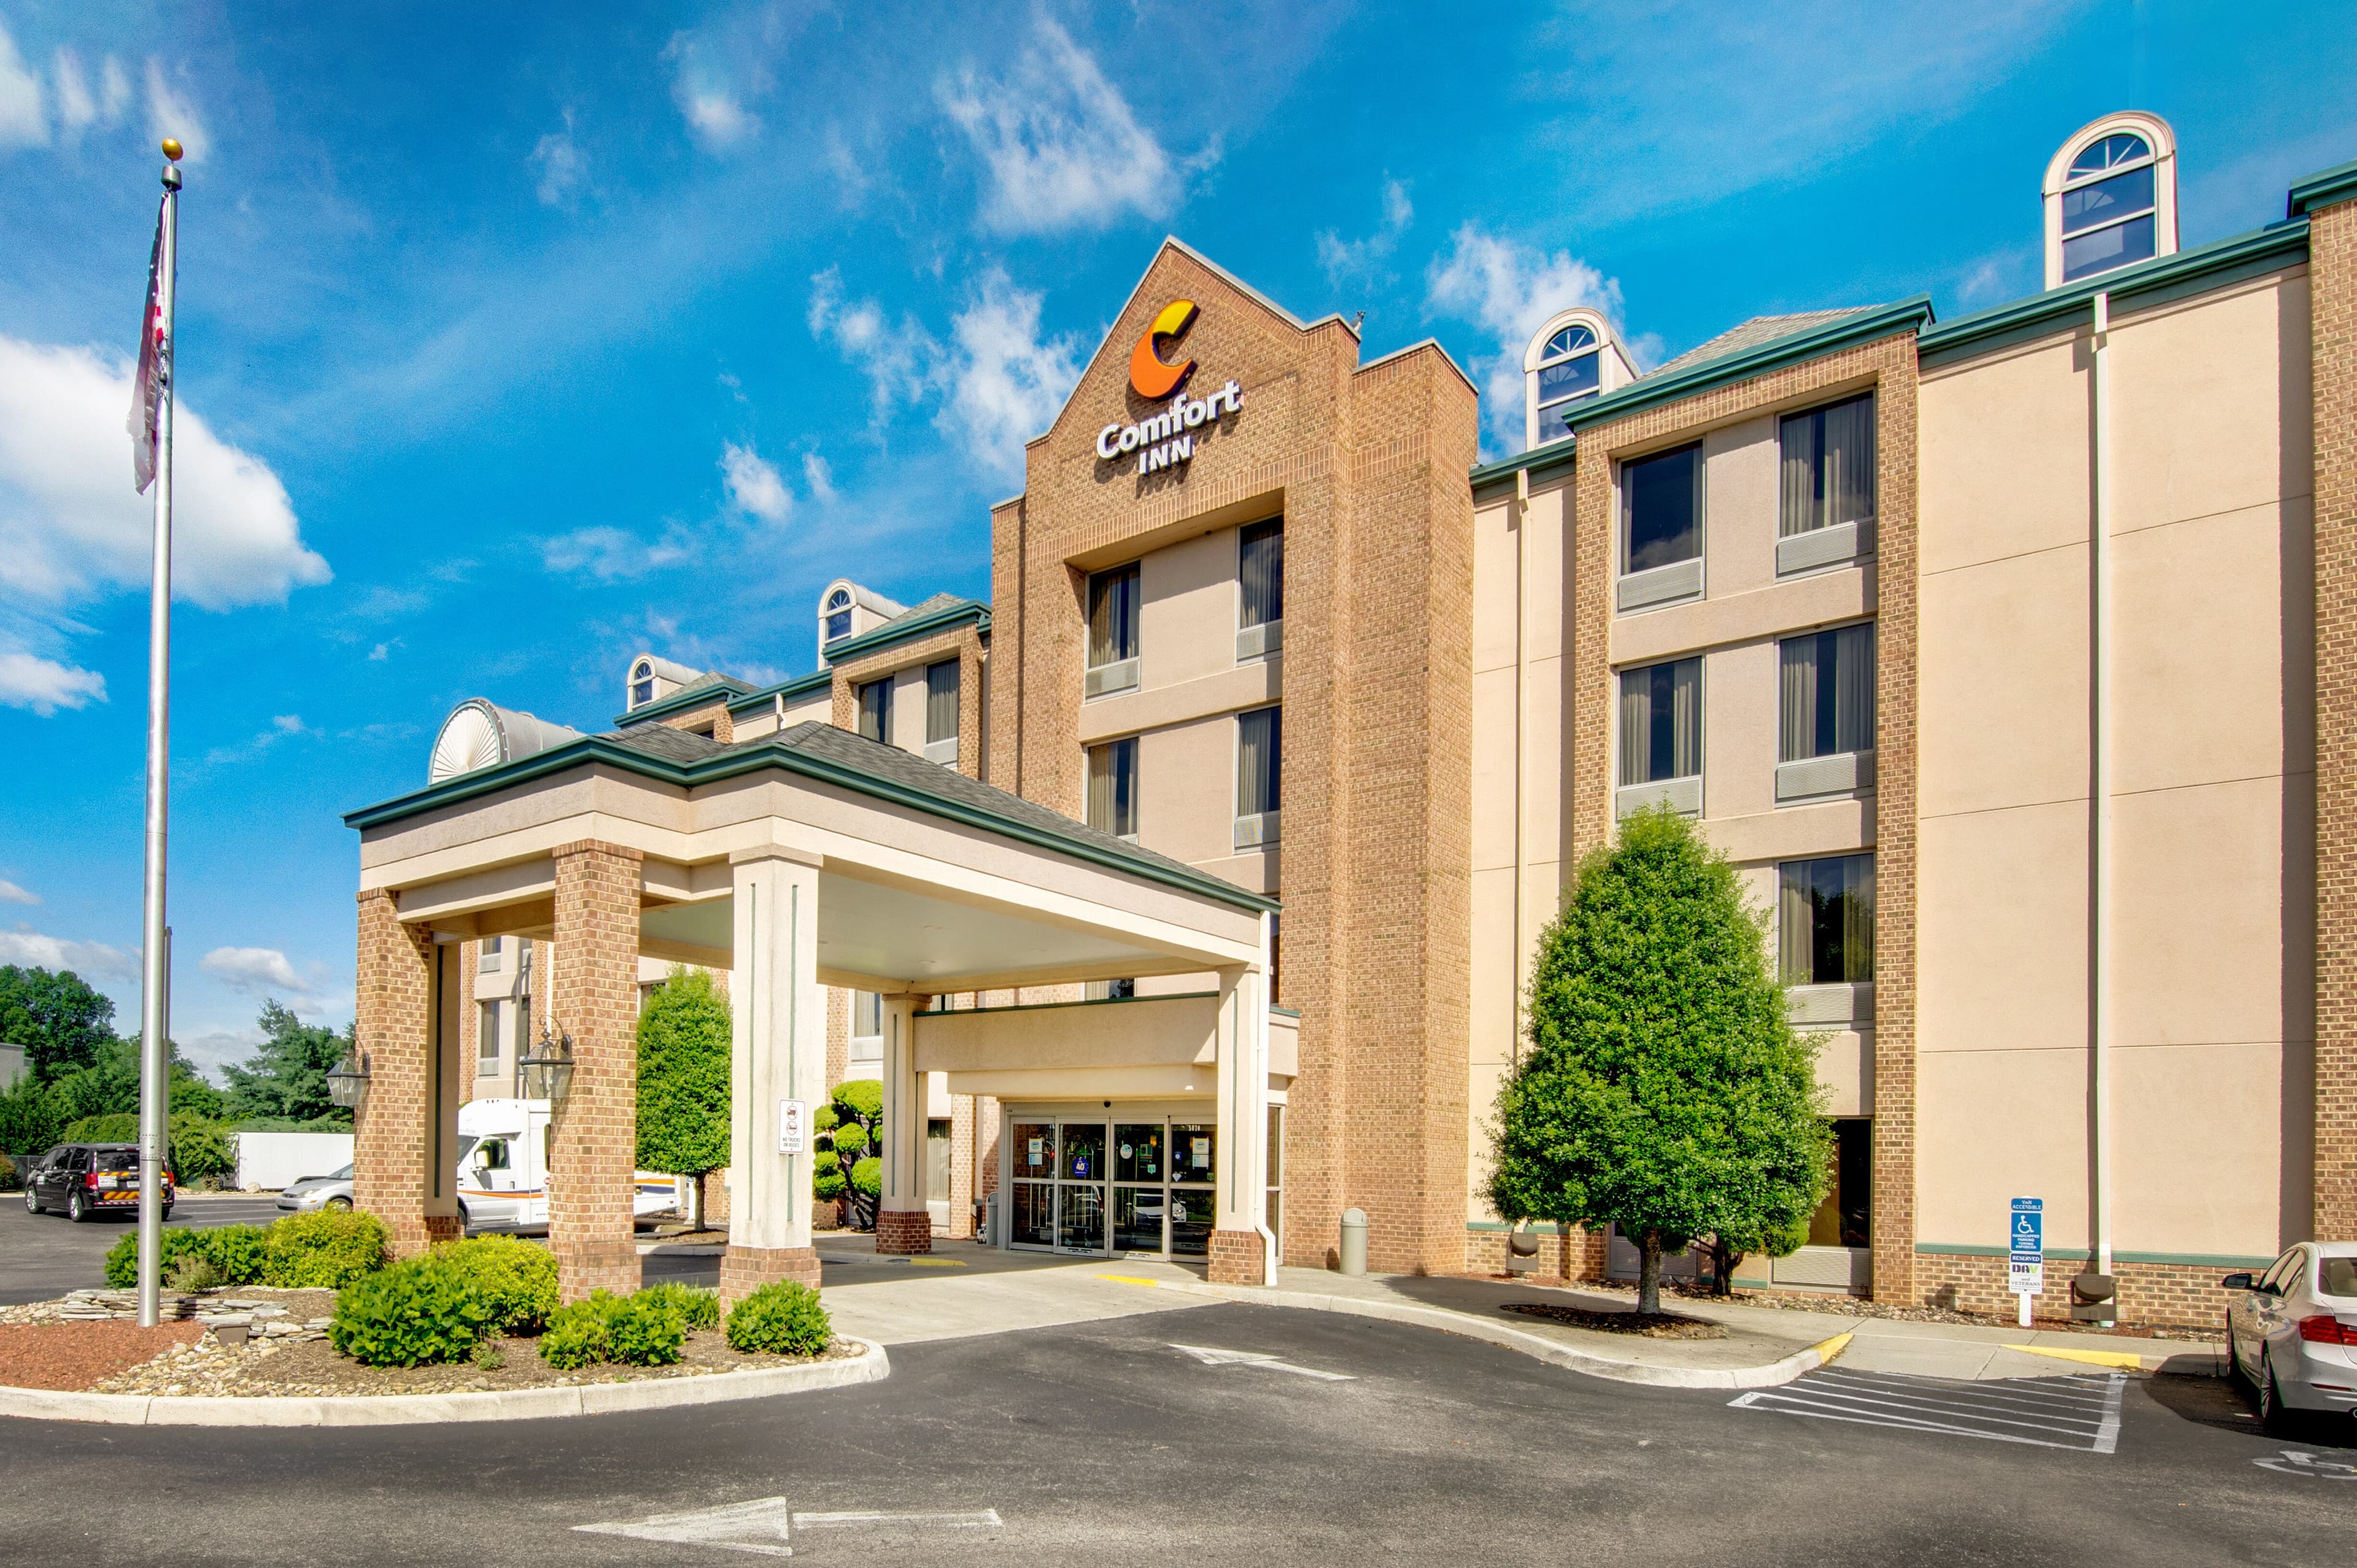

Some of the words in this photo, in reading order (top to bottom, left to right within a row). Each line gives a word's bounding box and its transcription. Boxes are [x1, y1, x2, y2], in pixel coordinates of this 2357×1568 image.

[1097, 380, 1240, 460] Comfort
[1139, 435, 1193, 475] INN
[2012, 1264, 2038, 1273] DAV
